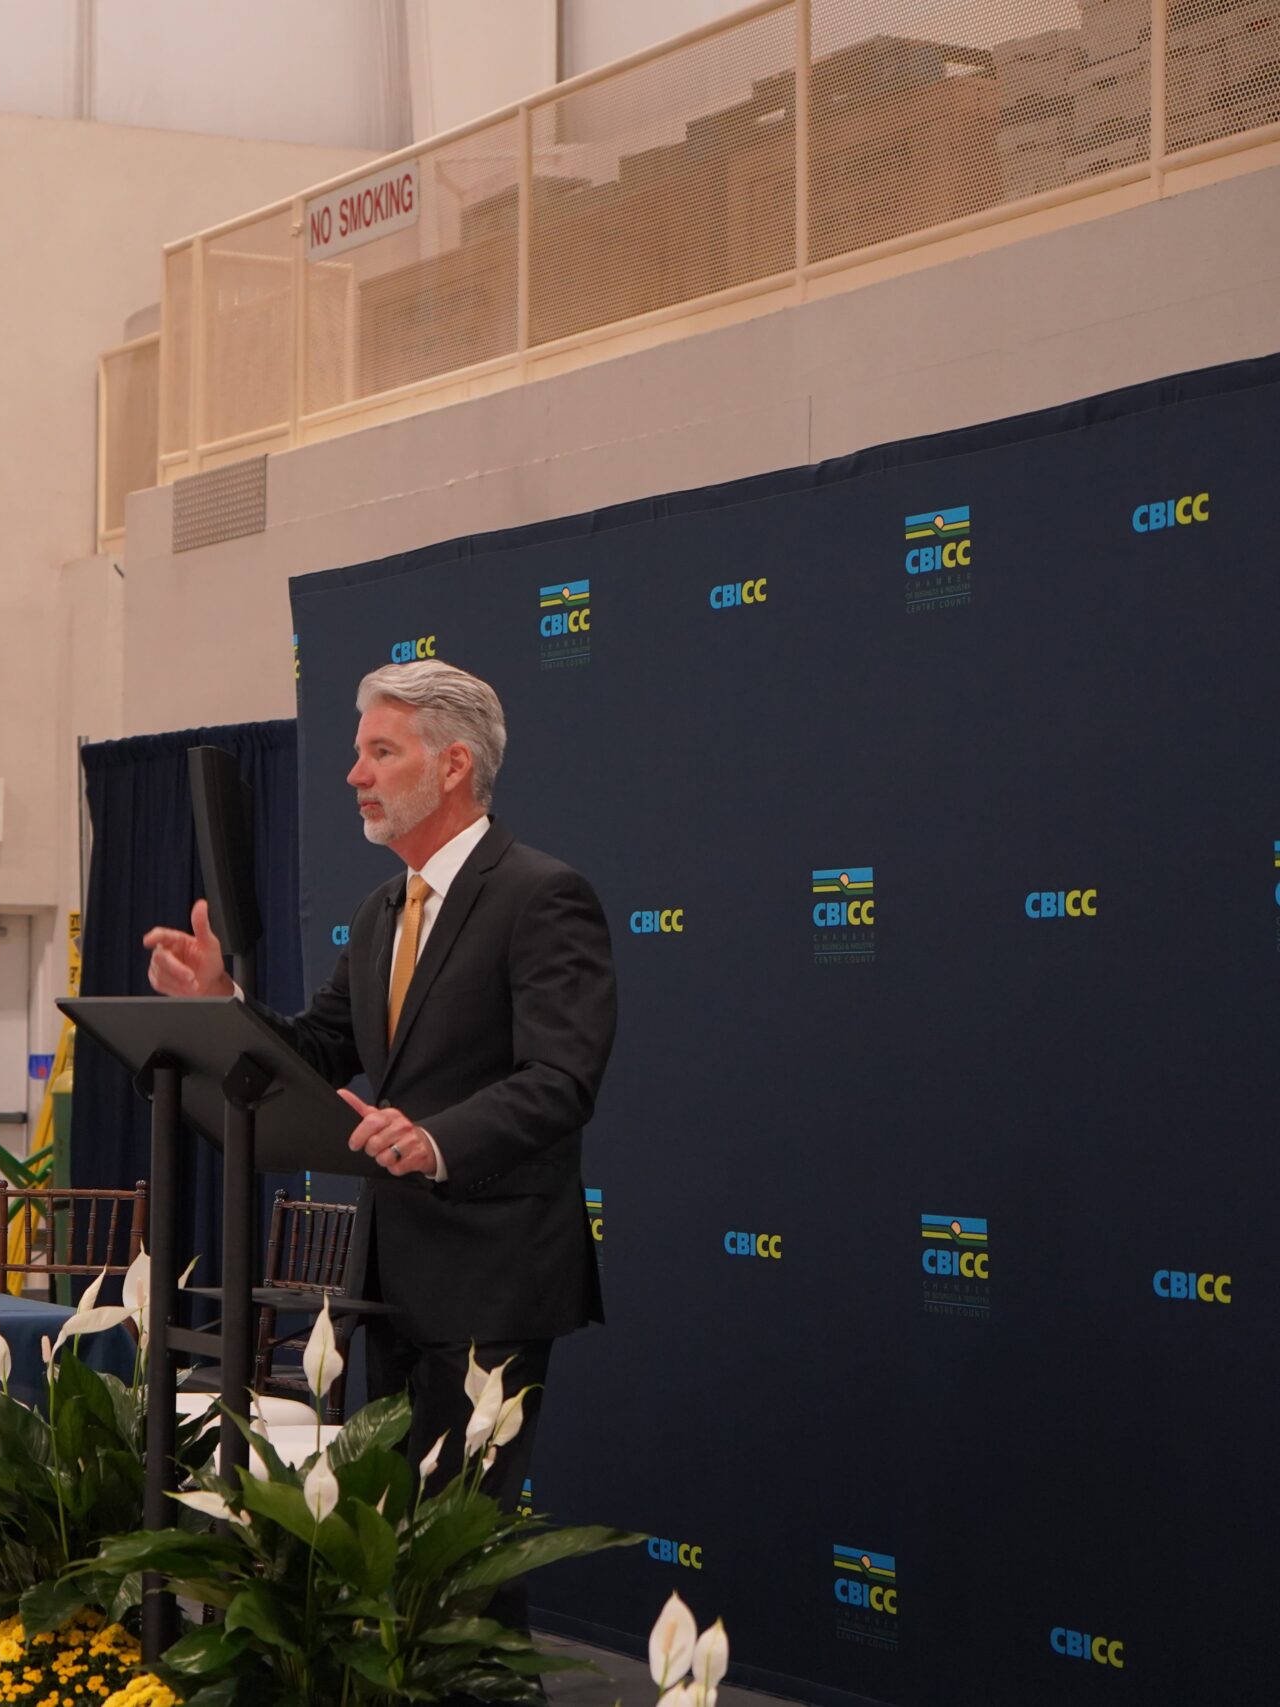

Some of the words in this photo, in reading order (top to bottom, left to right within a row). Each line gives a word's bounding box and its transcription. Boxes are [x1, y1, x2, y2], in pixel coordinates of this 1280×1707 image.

[310, 206, 332, 249] NO
[339, 173, 413, 238] SMOKING
[1132, 492, 1210, 533] CBICC
[904, 540, 971, 575] CBICC
[709, 578, 768, 609] CBICC
[539, 608, 590, 637] CBICC
[391, 635, 435, 664] CBICC
[812, 900, 875, 927] CBICC
[1024, 889, 1097, 919] CBICC
[629, 909, 683, 933] CBICC
[723, 1231, 782, 1259] CBICC
[922, 1248, 989, 1279] CBICC
[1152, 1269, 1231, 1304] CBICC
[647, 1537, 702, 1569] CBICC
[834, 1578, 897, 1614] CBICC
[1050, 1627, 1123, 1668] CBICC
